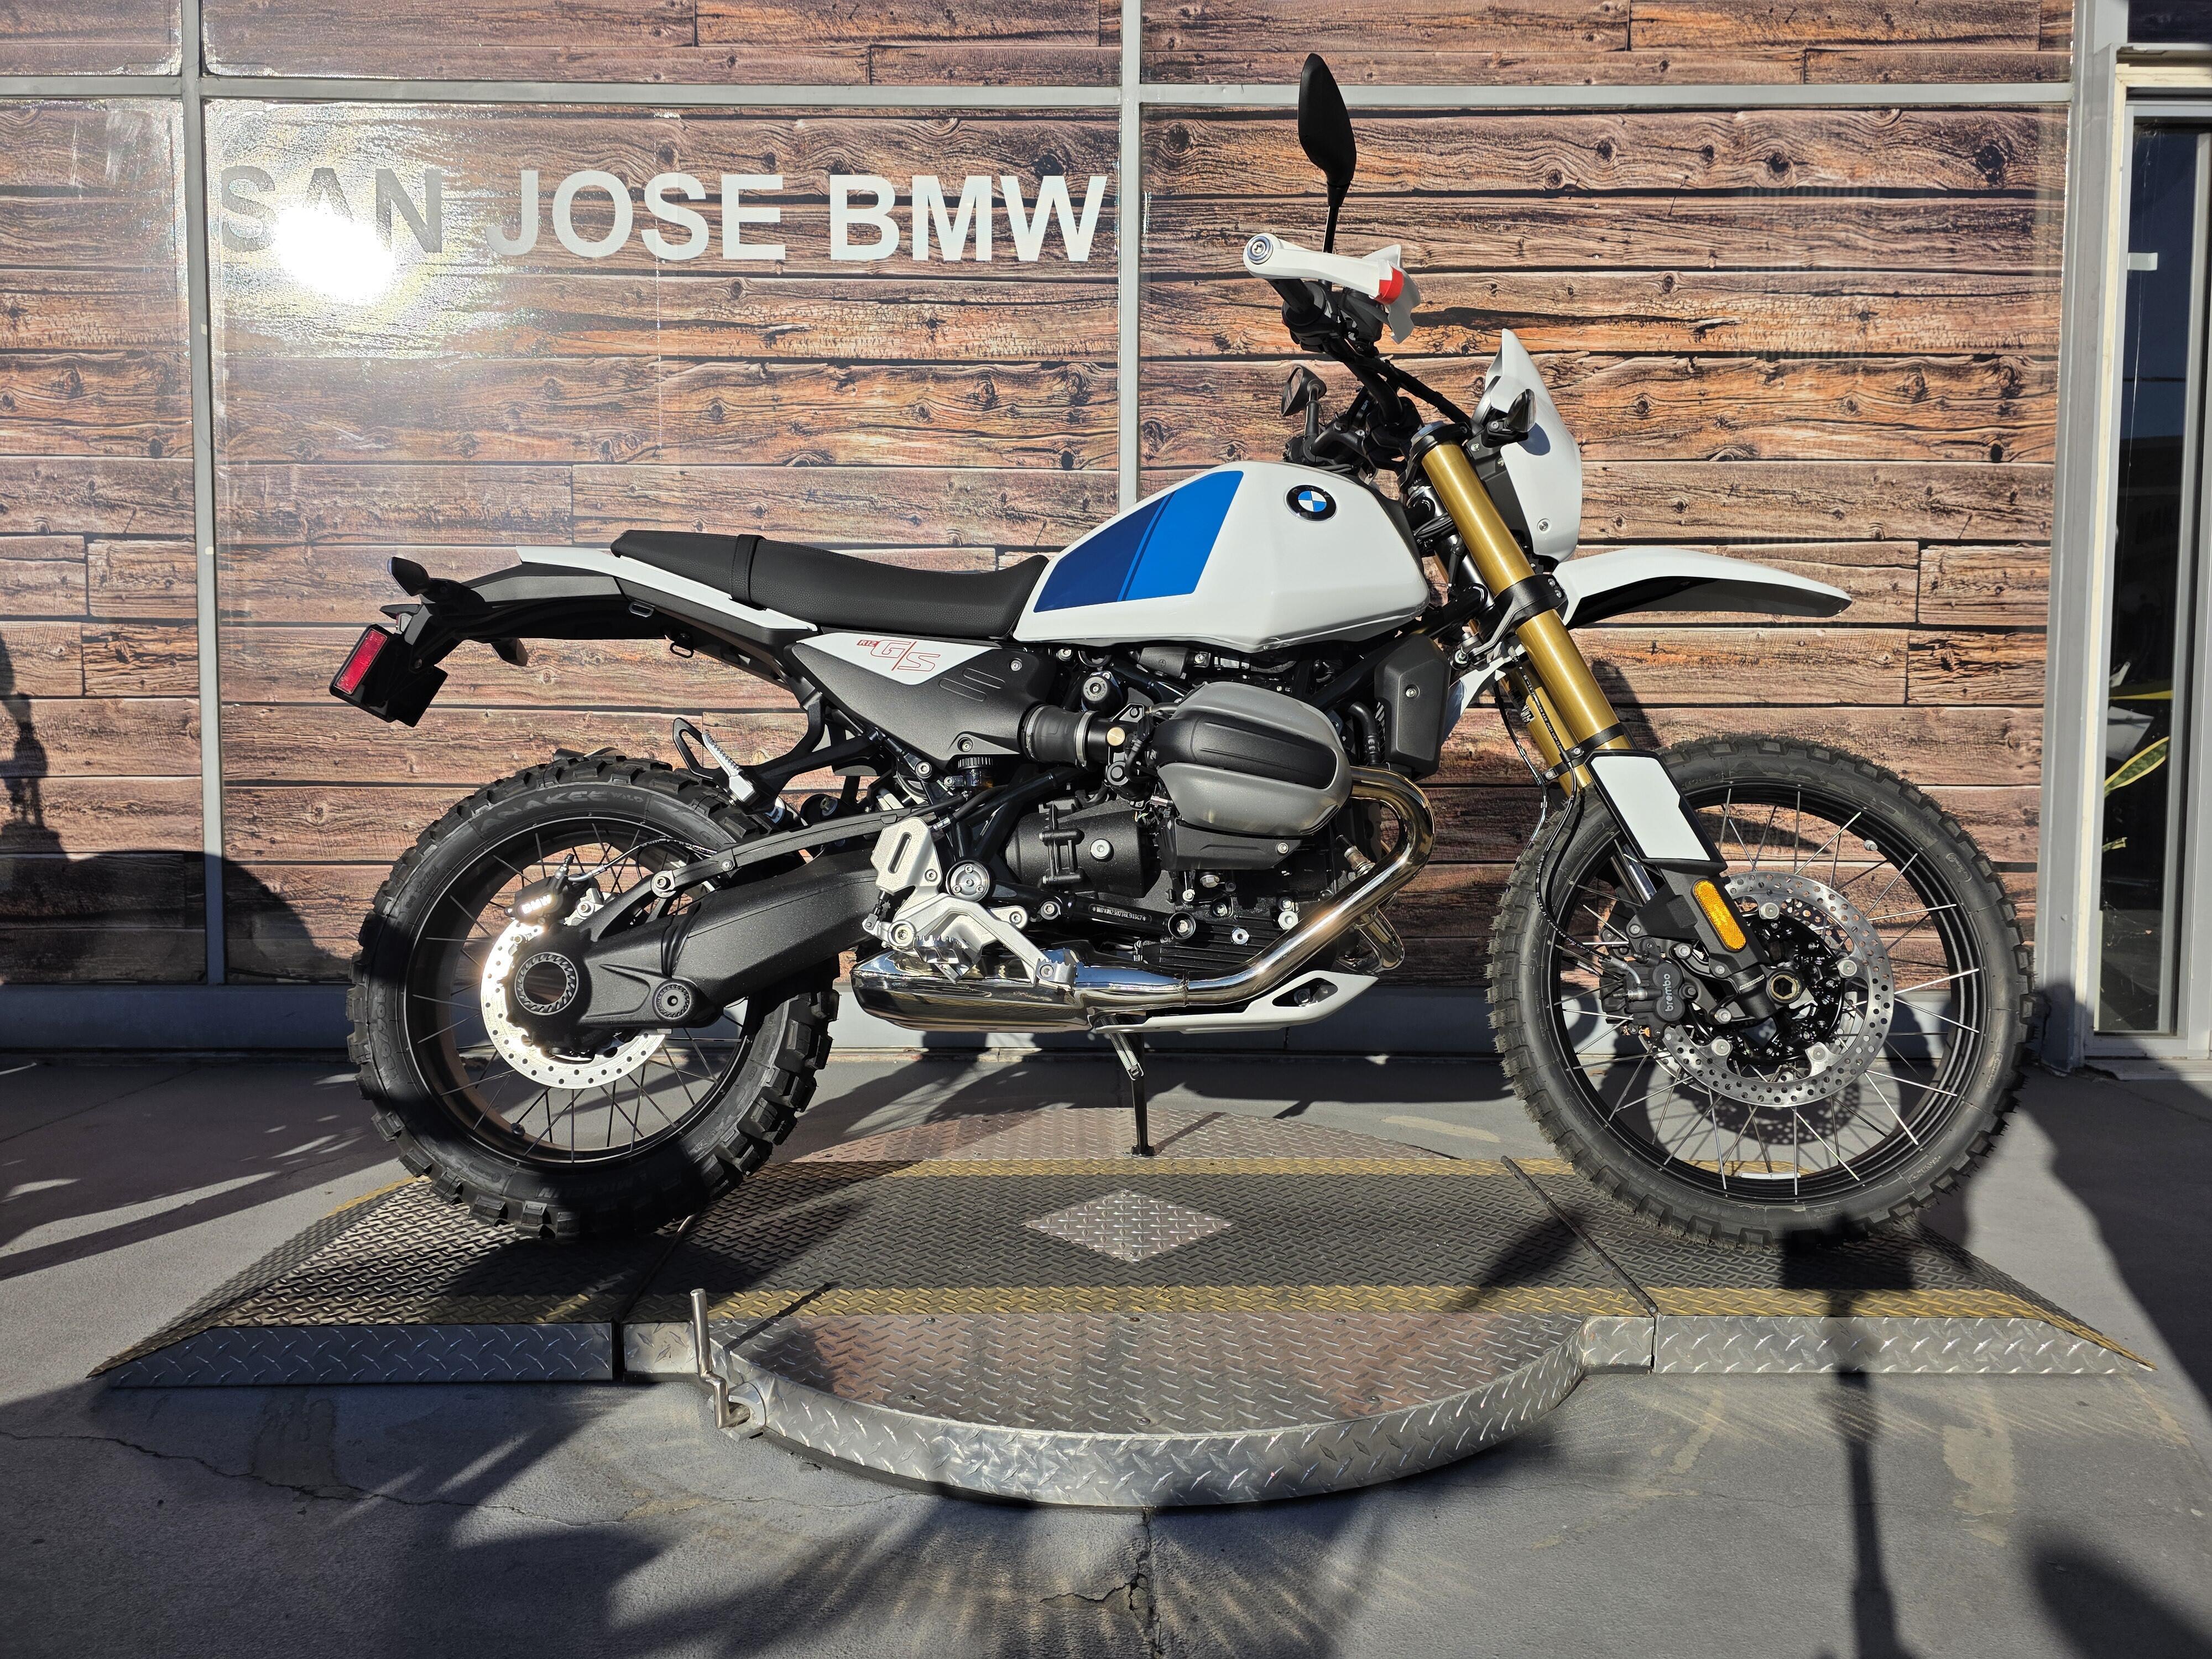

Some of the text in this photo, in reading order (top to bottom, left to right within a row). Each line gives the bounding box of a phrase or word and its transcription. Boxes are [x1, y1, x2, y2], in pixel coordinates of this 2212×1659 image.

[485, 169, 786, 260] JOSE
[830, 174, 1108, 262] BMW
[1665, 972, 1674, 1012] brembo
